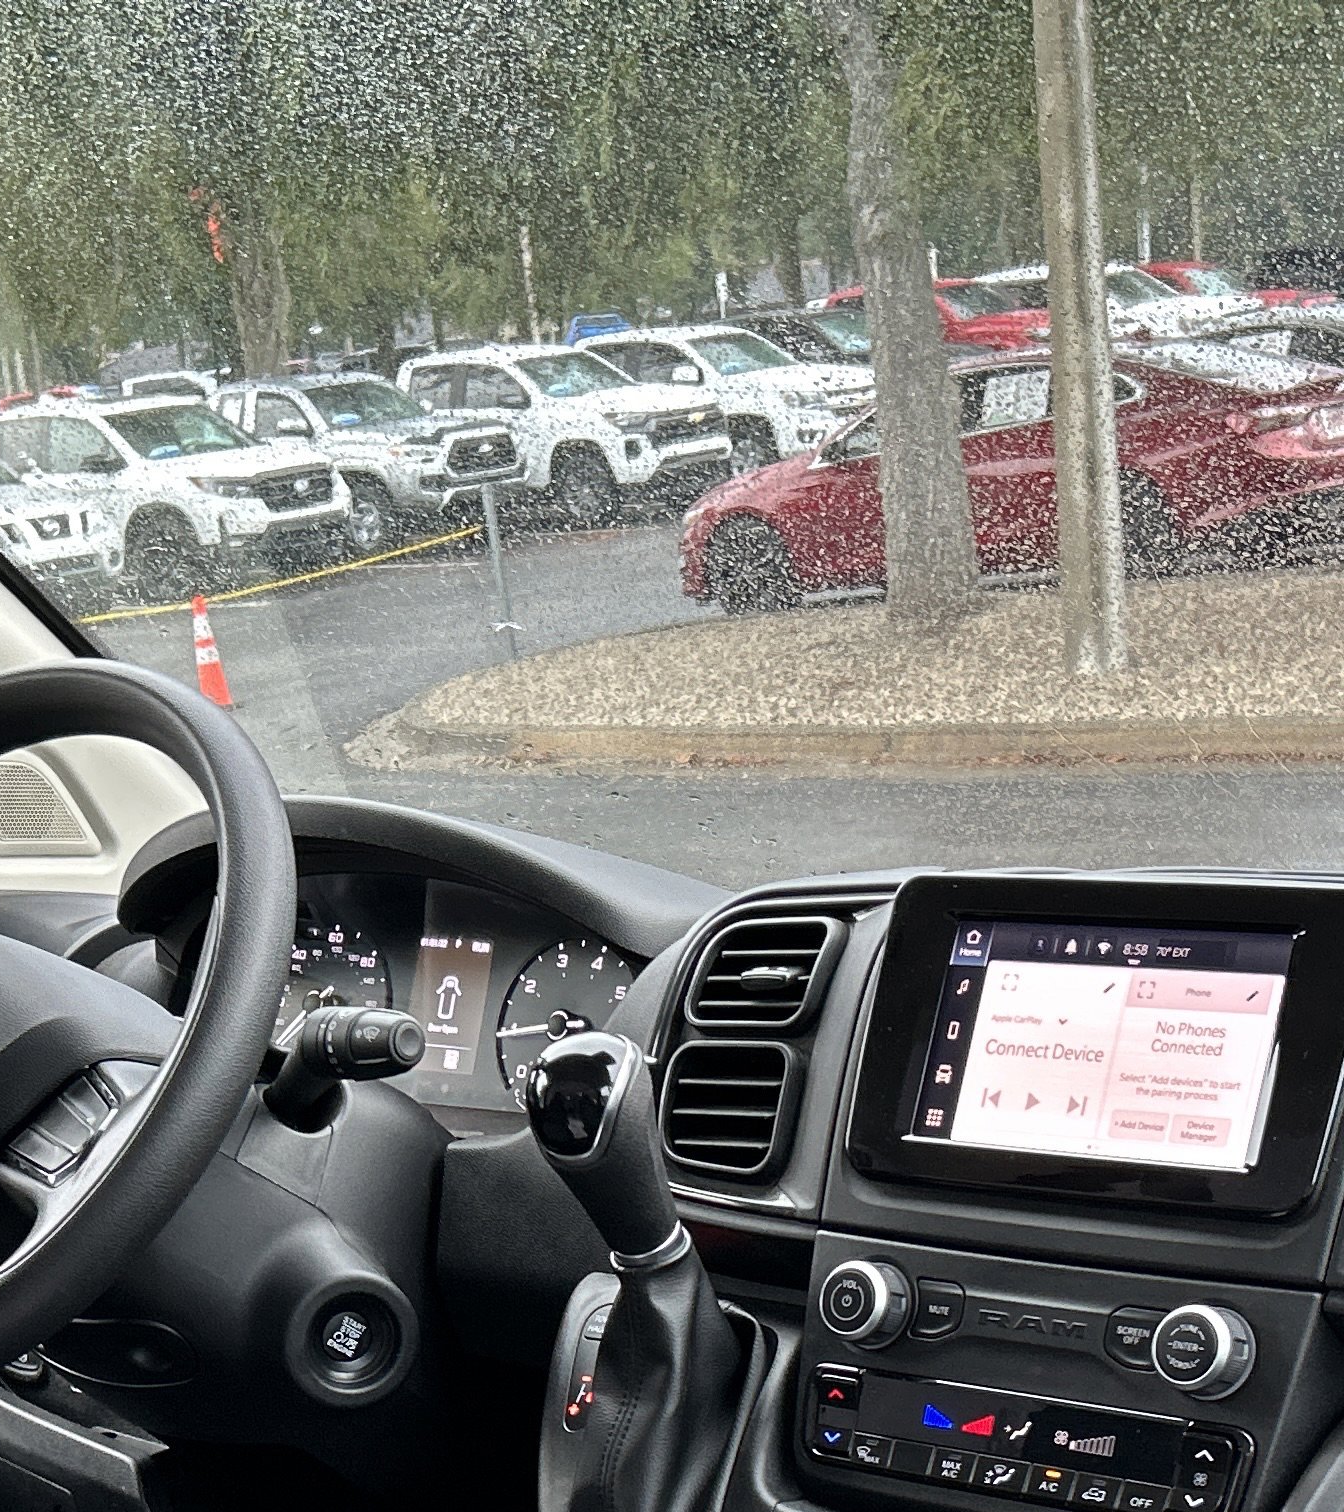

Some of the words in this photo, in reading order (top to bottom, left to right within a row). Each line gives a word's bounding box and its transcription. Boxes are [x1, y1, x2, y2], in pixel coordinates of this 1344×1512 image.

[328, 931, 344, 943] 60
[1122, 943, 1149, 956] 8:58
[1172, 947, 1191, 958] EXT
[556, 953, 569, 968] 3
[590, 956, 604, 970] 4
[524, 979, 537, 994] 2
[614, 985, 627, 1000] 5
[1185, 987, 1212, 998] Phone
[991, 1013, 1014, 1025] Apple
[1016, 1014, 1043, 1026] CarPlay
[1156, 1020, 1175, 1035] No
[1177, 1022, 1227, 1039] Phones
[985, 1038, 1049, 1058] Connect
[1052, 1043, 1105, 1063] Device
[1150, 1038, 1224, 1057] Connected
[515, 1064, 528, 1079] 0
[1119, 1072, 1146, 1083] Select
[1209, 1080, 1218, 1089] to
[1220, 1081, 1241, 1091] start
[1136, 1086, 1149, 1096] the
[1151, 1088, 1182, 1101] pairing
[1120, 1119, 1137, 1130] Add
[1138, 1121, 1165, 1132] Device
[1186, 1120, 1215, 1131] Device
[1180, 1130, 1217, 1142] Manager
[842, 1279, 858, 1290] VOL
[928, 1304, 950, 1316] MUTE
[342, 1315, 367, 1333] START
[977, 1308, 1089, 1340] RAM
[1116, 1325, 1151, 1338] SCREEN
[1122, 1335, 1141, 1345] OFF
[941, 1459, 962, 1470] MAX
[941, 1468, 958, 1479] A/C
[1039, 1480, 1059, 1493] A/C
[1129, 1496, 1154, 1509] OFF
